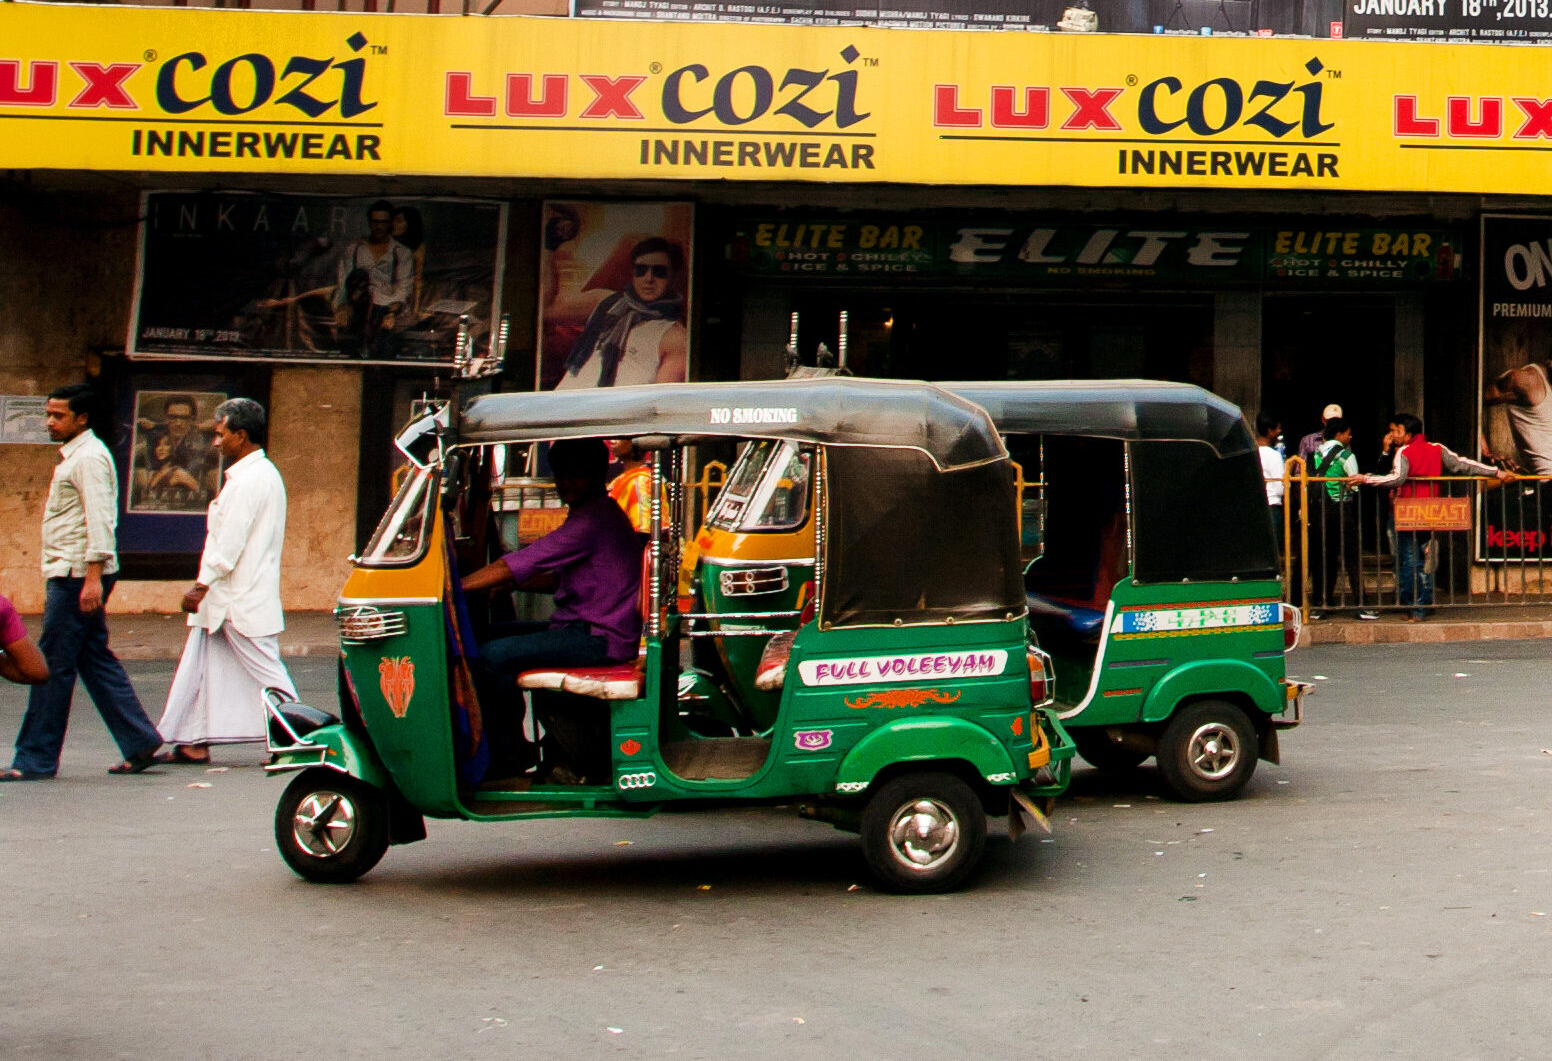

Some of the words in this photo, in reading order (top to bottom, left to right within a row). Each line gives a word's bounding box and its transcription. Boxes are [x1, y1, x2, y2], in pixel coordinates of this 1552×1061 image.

[131, 129, 382, 161] INNERWEAR
[639, 139, 876, 169] INNERWEAR
[1118, 149, 1340, 178] INNERWEAR
[153, 202, 347, 234] INKAAR
[754, 222, 847, 250] ELITE
[857, 223, 925, 251] BAR
[948, 227, 1251, 267] ELITE
[1273, 231, 1361, 256] ELITE
[1371, 232, 1432, 258] BAR
[787, 252, 831, 262] HOT
[794, 263, 828, 272] ICE
[858, 264, 918, 273] SPICE
[1339, 259, 1409, 269] CHILLY
[1287, 269, 1321, 278] ICE
[1347, 269, 1405, 279] SPICE
[1493, 302, 1552, 318] PREMIUM
[709, 407, 731, 424] NO
[732, 406, 799, 424] SMOKING
[1396, 503, 1468, 521] CONCAST
[1487, 524, 1546, 553] keep
[815, 659, 872, 683] FULL
[876, 654, 997, 678] VOLEEYAM
